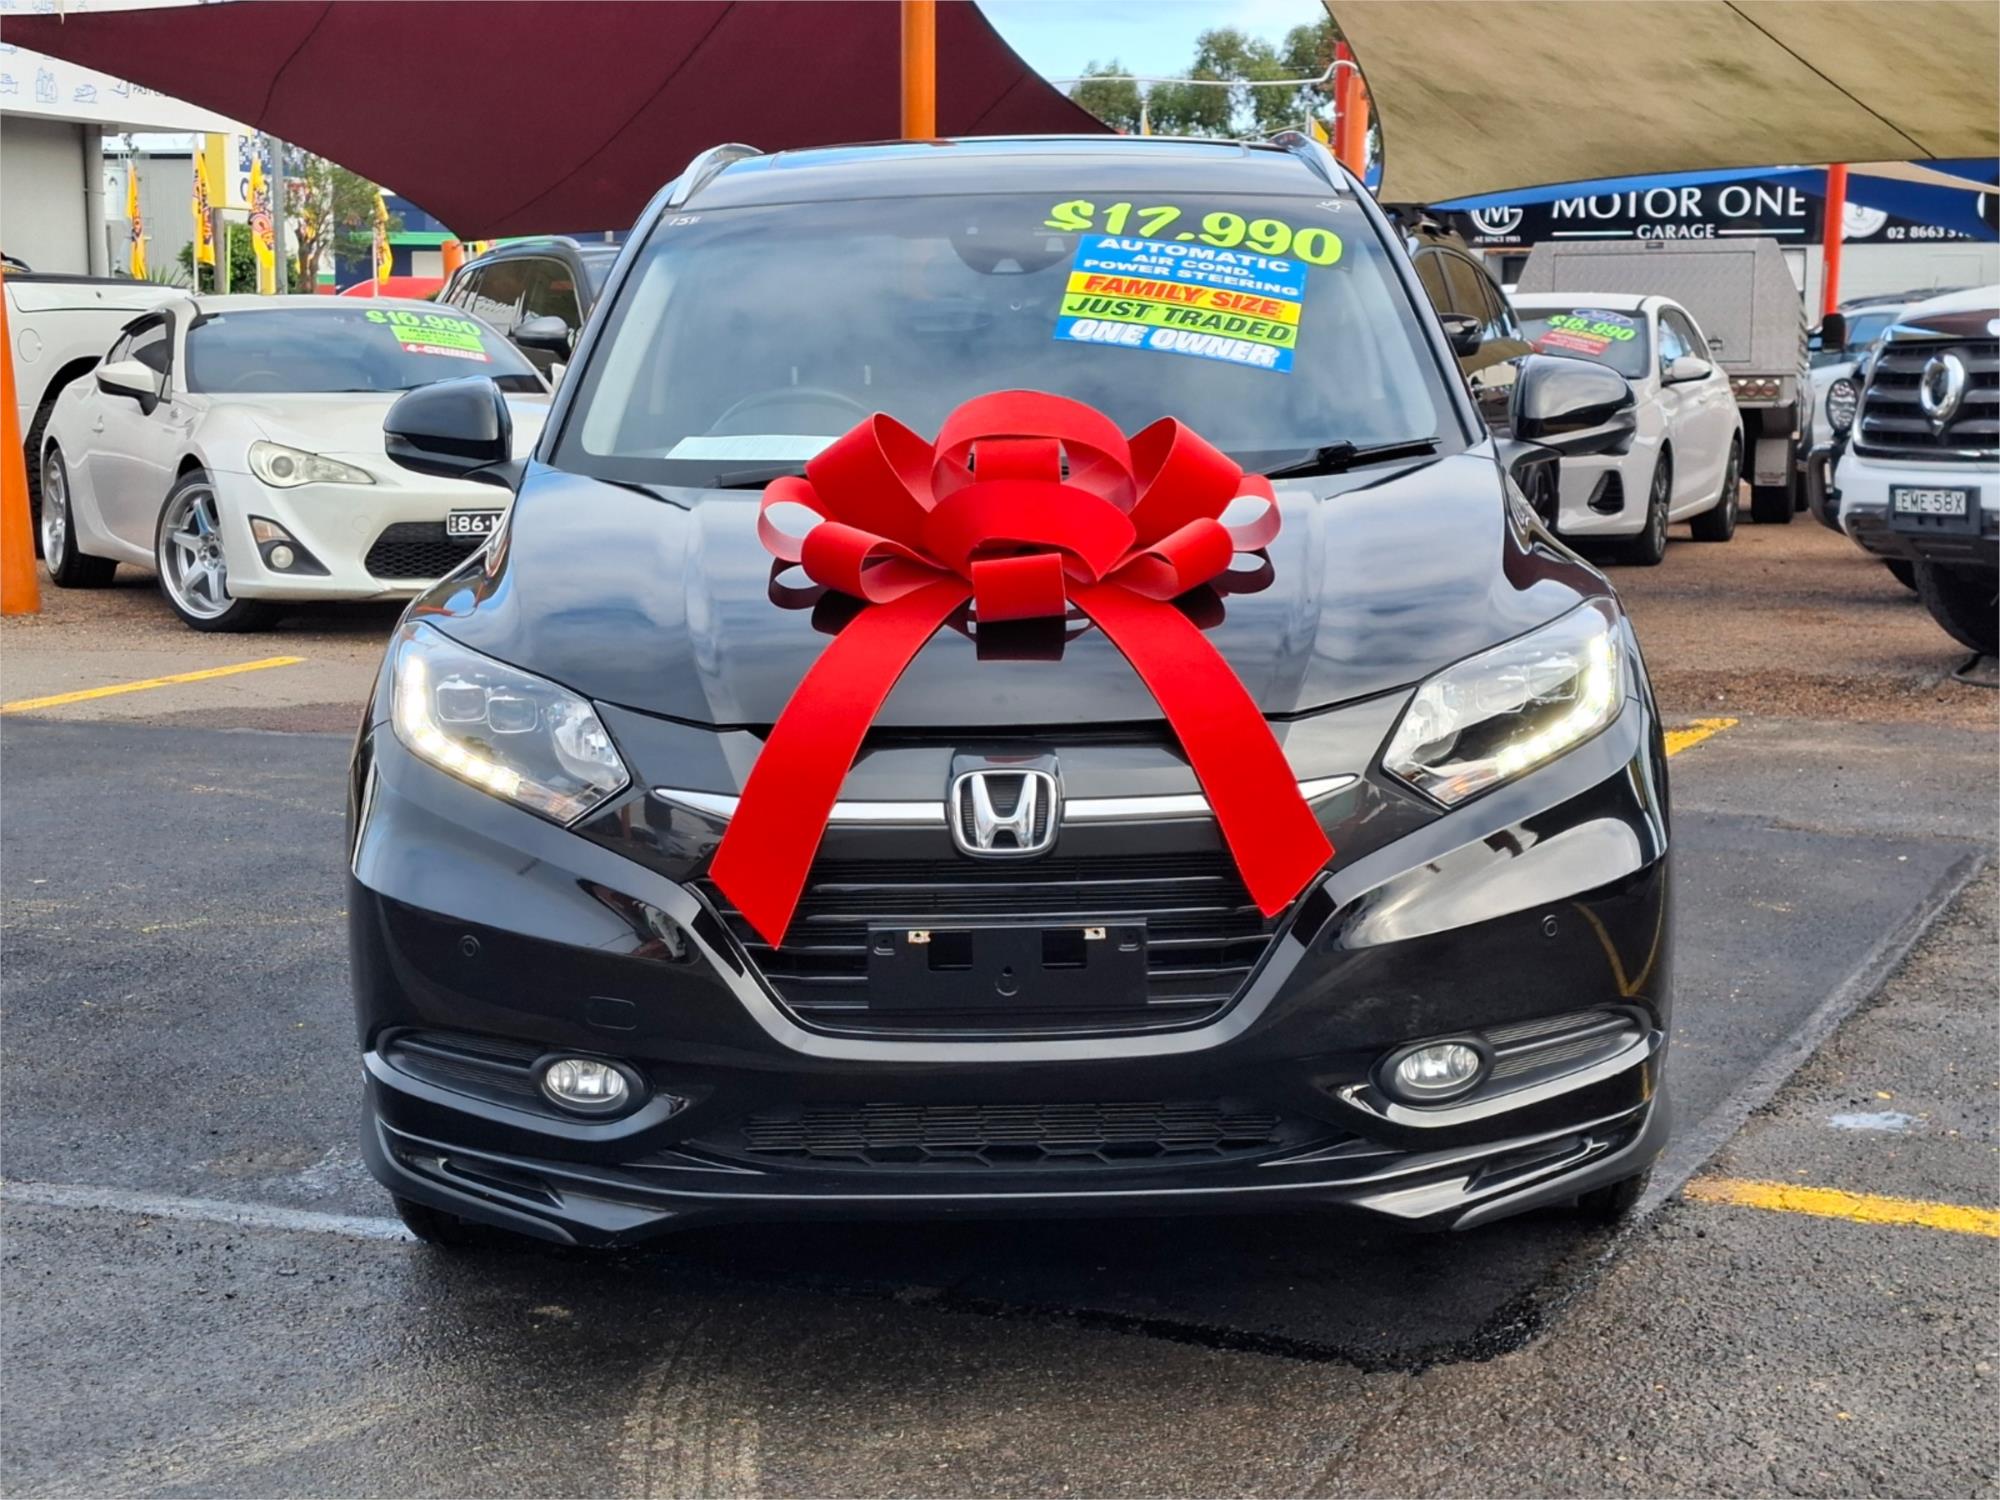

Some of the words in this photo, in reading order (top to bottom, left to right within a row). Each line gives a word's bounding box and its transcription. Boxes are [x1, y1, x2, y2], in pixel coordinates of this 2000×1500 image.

[1552, 187, 1703, 219] MOTOR
[1718, 185, 1806, 217] ONE
[1043, 200, 1343, 265] $17.990
[1636, 223, 1715, 239] GARAGE
[1886, 227, 1905, 239] 02
[1909, 225, 1944, 239] 8663
[1097, 237, 1291, 273] AUTOMATIC
[1132, 253, 1175, 267] AIR
[1181, 259, 1254, 278] COND.
[1083, 259, 1170, 277] POWER
[1178, 269, 1299, 297] STEERING
[1083, 275, 1206, 304] FAMILY
[1210, 290, 1284, 317] SIZE
[1067, 297, 1153, 319] JUST
[1164, 306, 1291, 343] TRADED
[1069, 318, 1149, 345] ONE
[1150, 327, 1280, 368] OWNER
